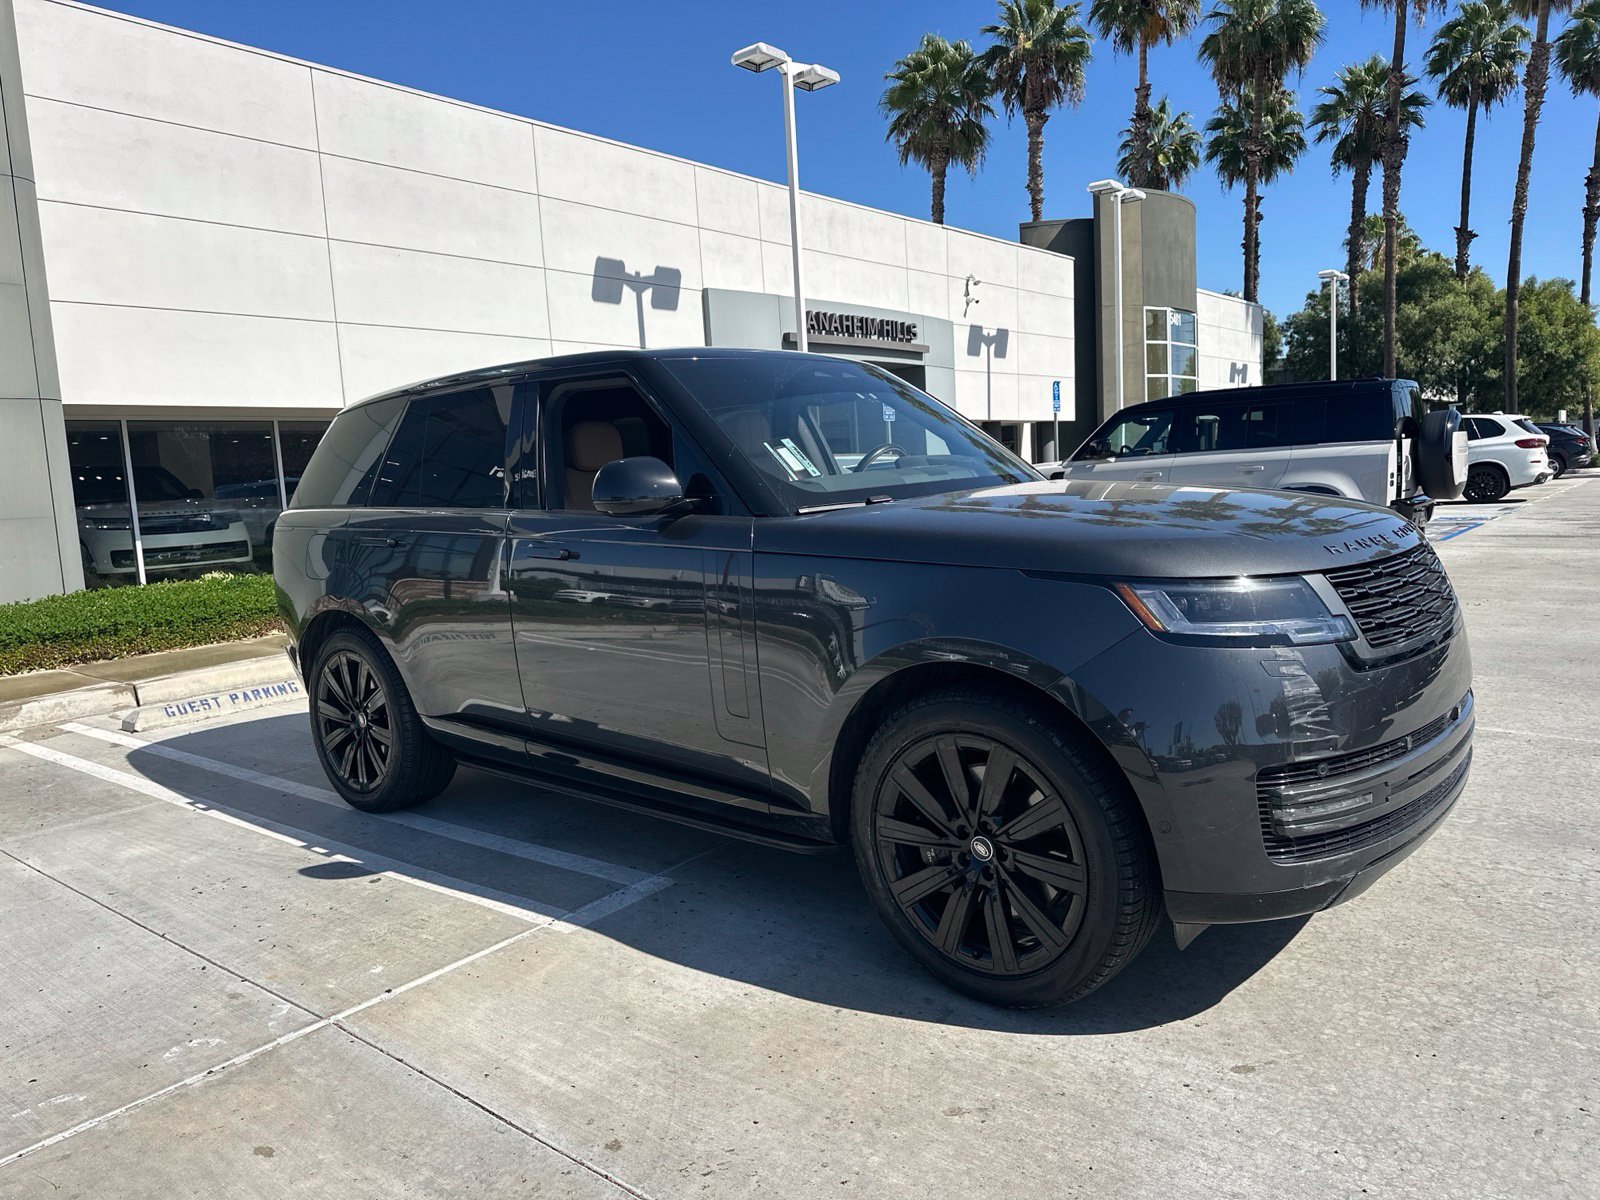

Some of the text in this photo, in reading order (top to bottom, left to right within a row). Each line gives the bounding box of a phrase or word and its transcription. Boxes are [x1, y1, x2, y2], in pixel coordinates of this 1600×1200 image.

[806, 310, 918, 340] ANAHEIM HILLS
[1323, 533, 1389, 555] RANGE
[163, 681, 299, 718] GUEST PARKING
